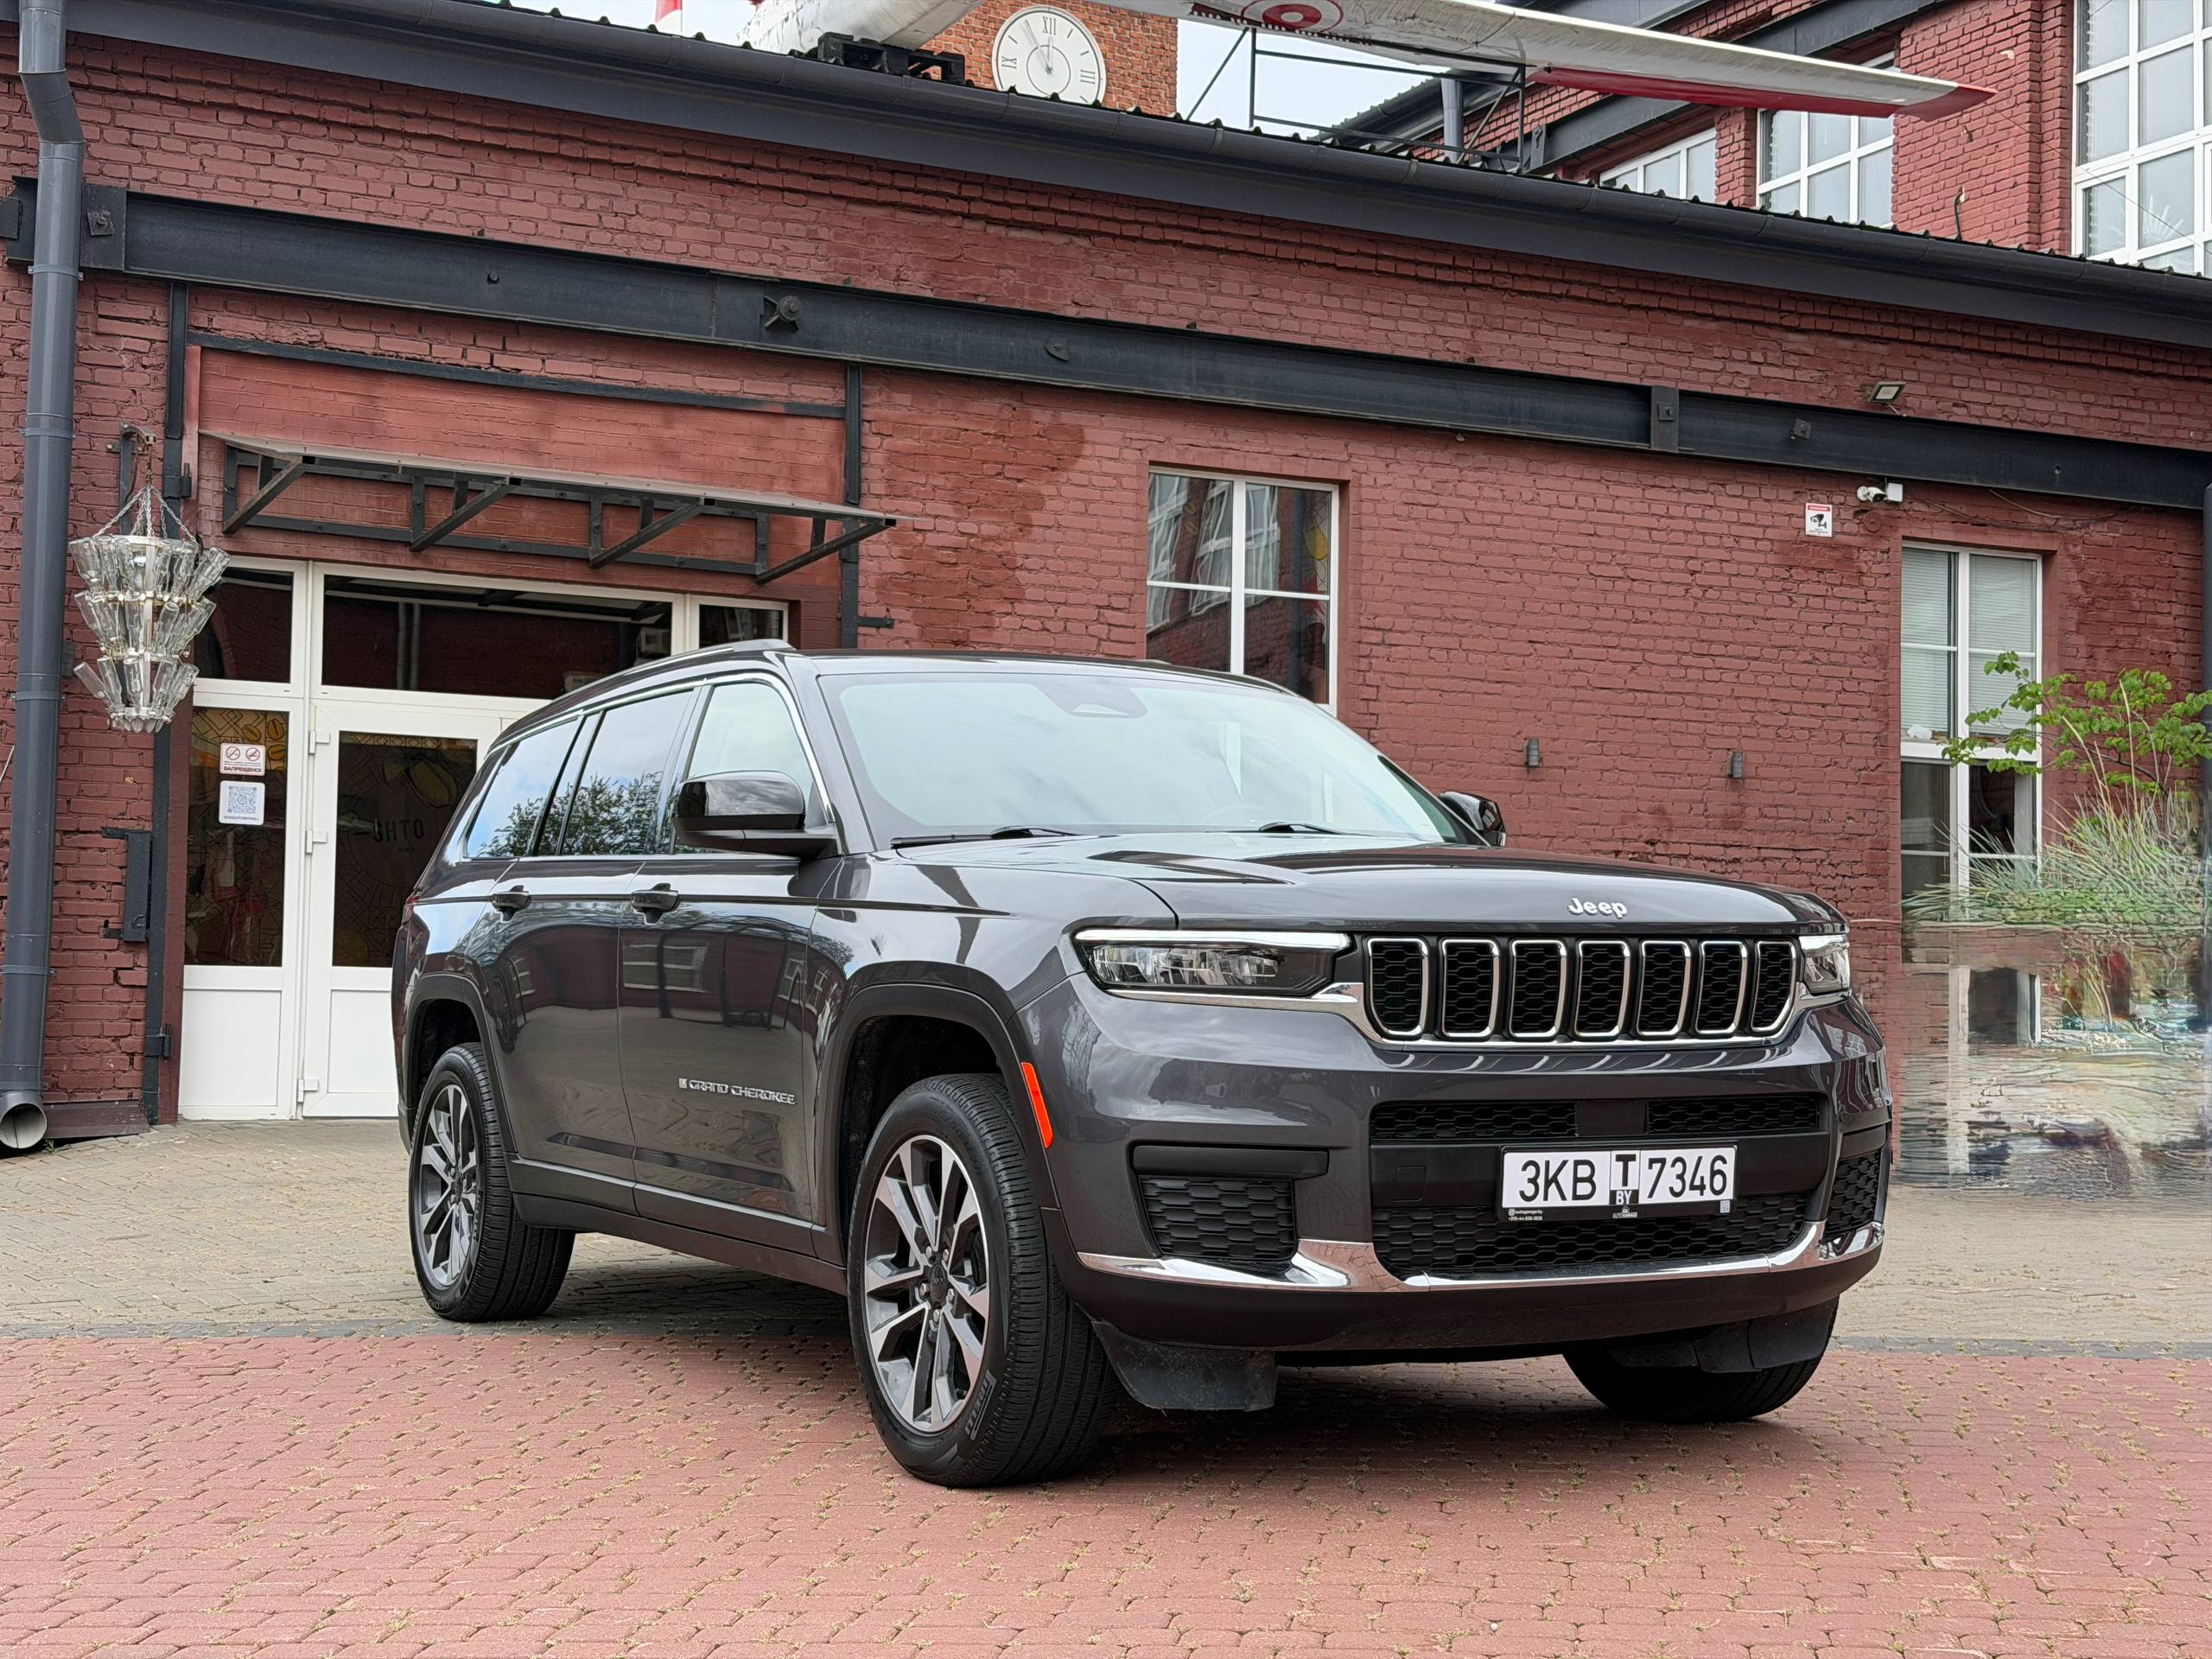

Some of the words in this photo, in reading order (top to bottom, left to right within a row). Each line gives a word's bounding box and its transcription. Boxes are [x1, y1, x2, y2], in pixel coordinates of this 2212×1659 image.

[1042, 16, 1057, 35] XII
[1001, 56, 1017, 70] IX
[1080, 69, 1096, 85] III
[1567, 897, 1628, 920] Jeep
[689, 1079, 728, 1094] GRAND
[730, 1085, 796, 1105] CHEROKEE
[1518, 1159, 1598, 1203] 3KB
[1615, 1154, 1637, 1188] T
[1647, 1154, 1728, 1199] 7346
[1615, 1190, 1633, 1205] BY
